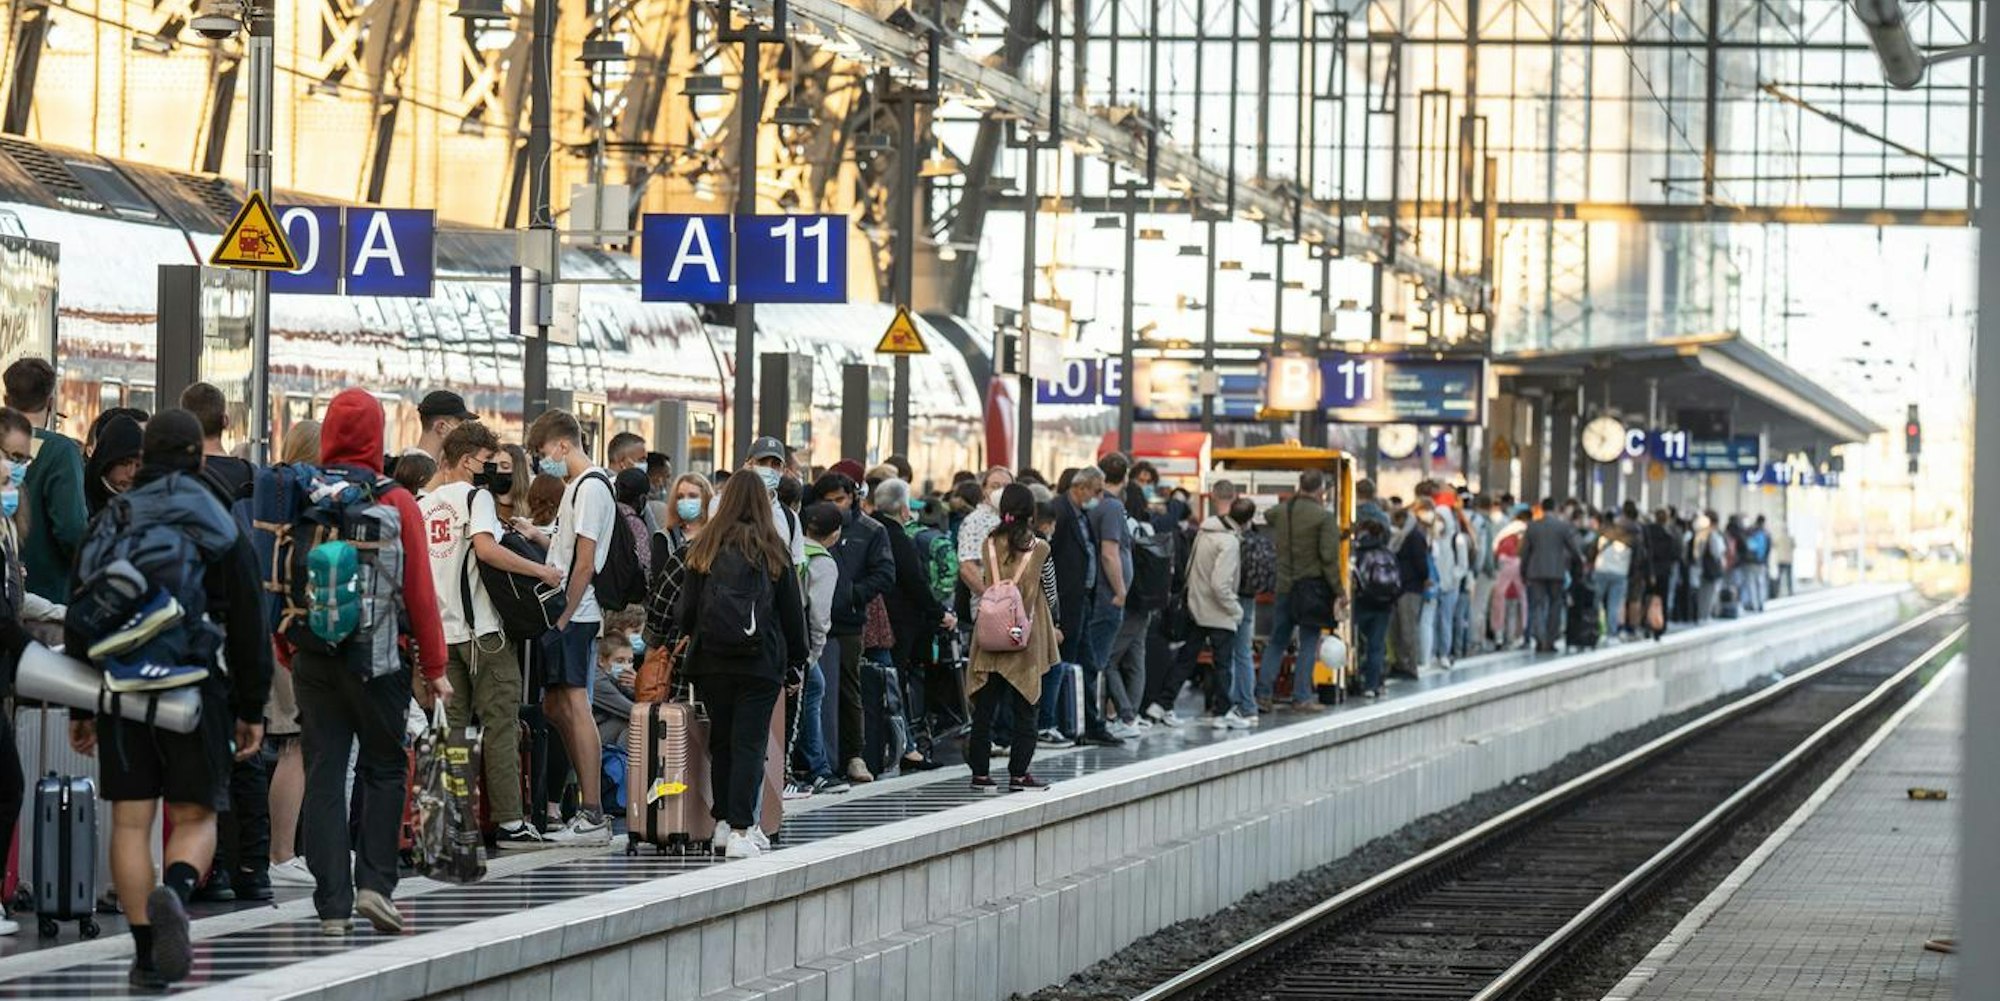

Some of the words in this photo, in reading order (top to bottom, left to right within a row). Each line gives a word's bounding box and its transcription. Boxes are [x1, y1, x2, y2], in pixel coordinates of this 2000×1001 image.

[352, 211, 405, 276] A
[667, 217, 721, 283] A
[770, 217, 829, 283] 11
[1280, 360, 1310, 400] B
[1337, 360, 1374, 400] 11
[1625, 428, 1646, 457] C
[1661, 431, 1686, 458] 11
[431, 517, 451, 544] DC
